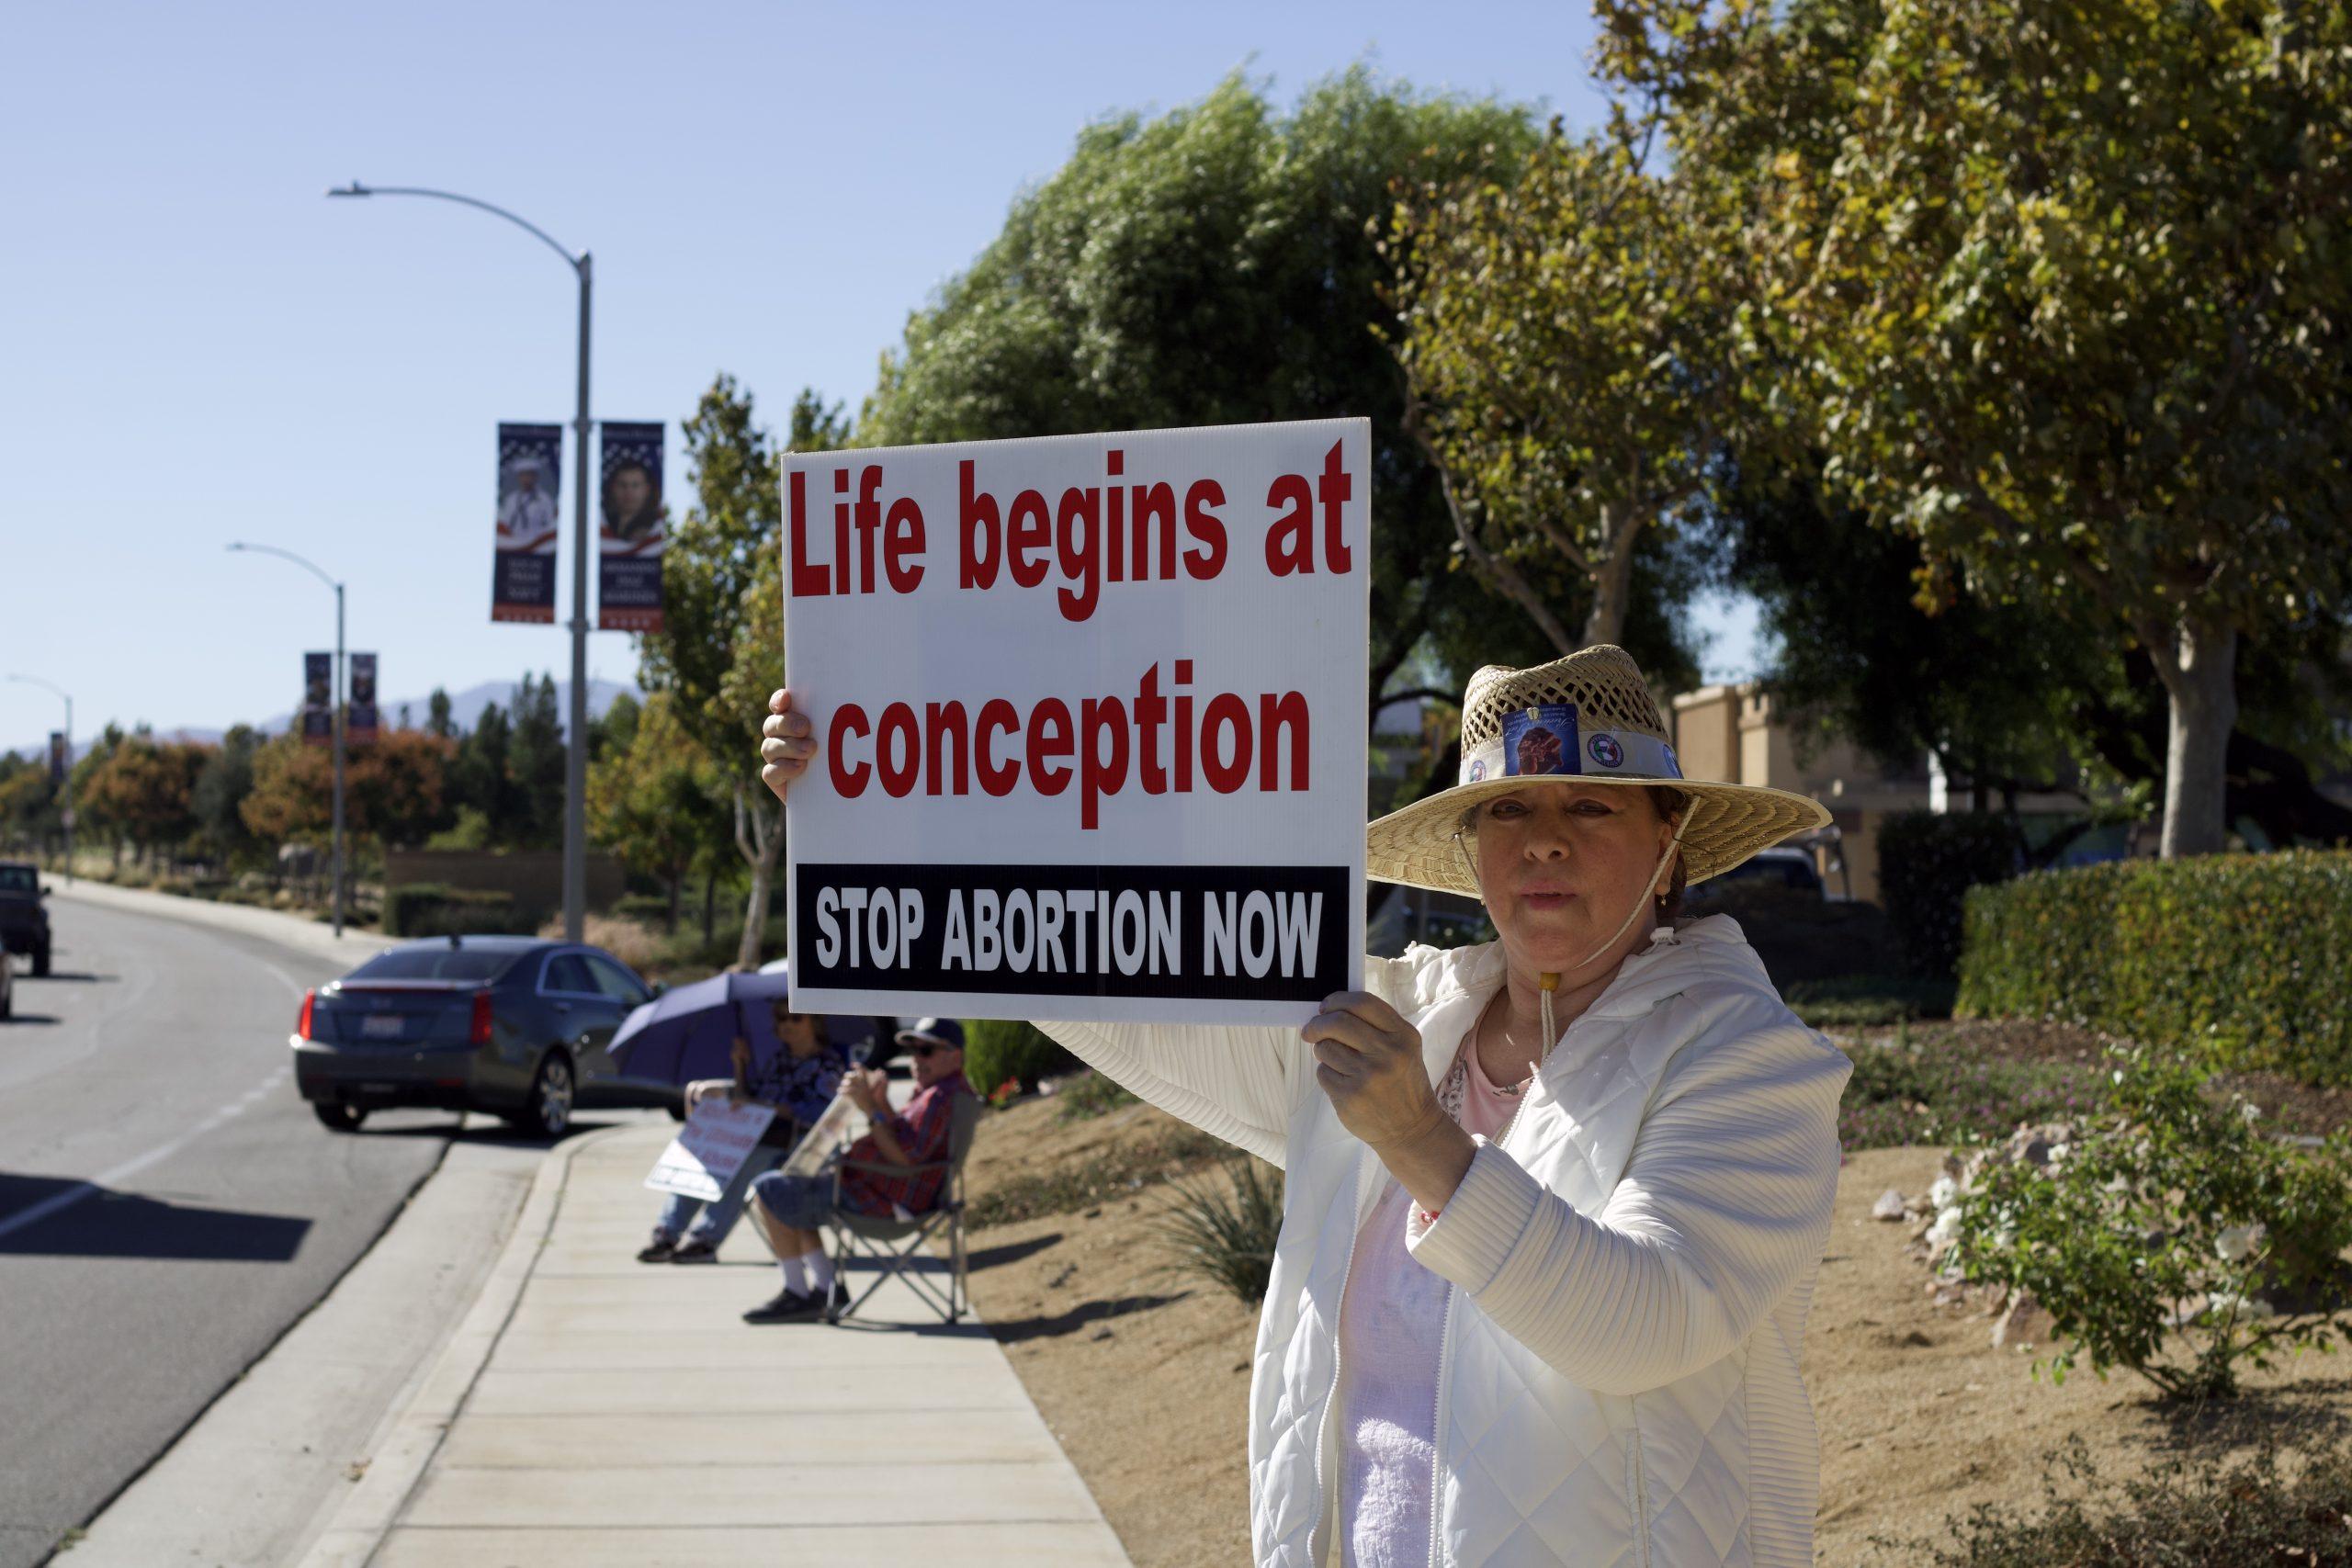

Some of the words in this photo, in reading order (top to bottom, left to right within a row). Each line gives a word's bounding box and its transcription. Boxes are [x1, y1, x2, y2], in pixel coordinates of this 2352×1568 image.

[790, 465, 926, 597] Life
[959, 450, 1228, 622] begins
[1265, 437, 1351, 577] at
[828, 660, 1309, 830] conception
[816, 886, 924, 970] STOP
[941, 887, 1182, 976] ABORTION
[1204, 890, 1323, 979] NOW
